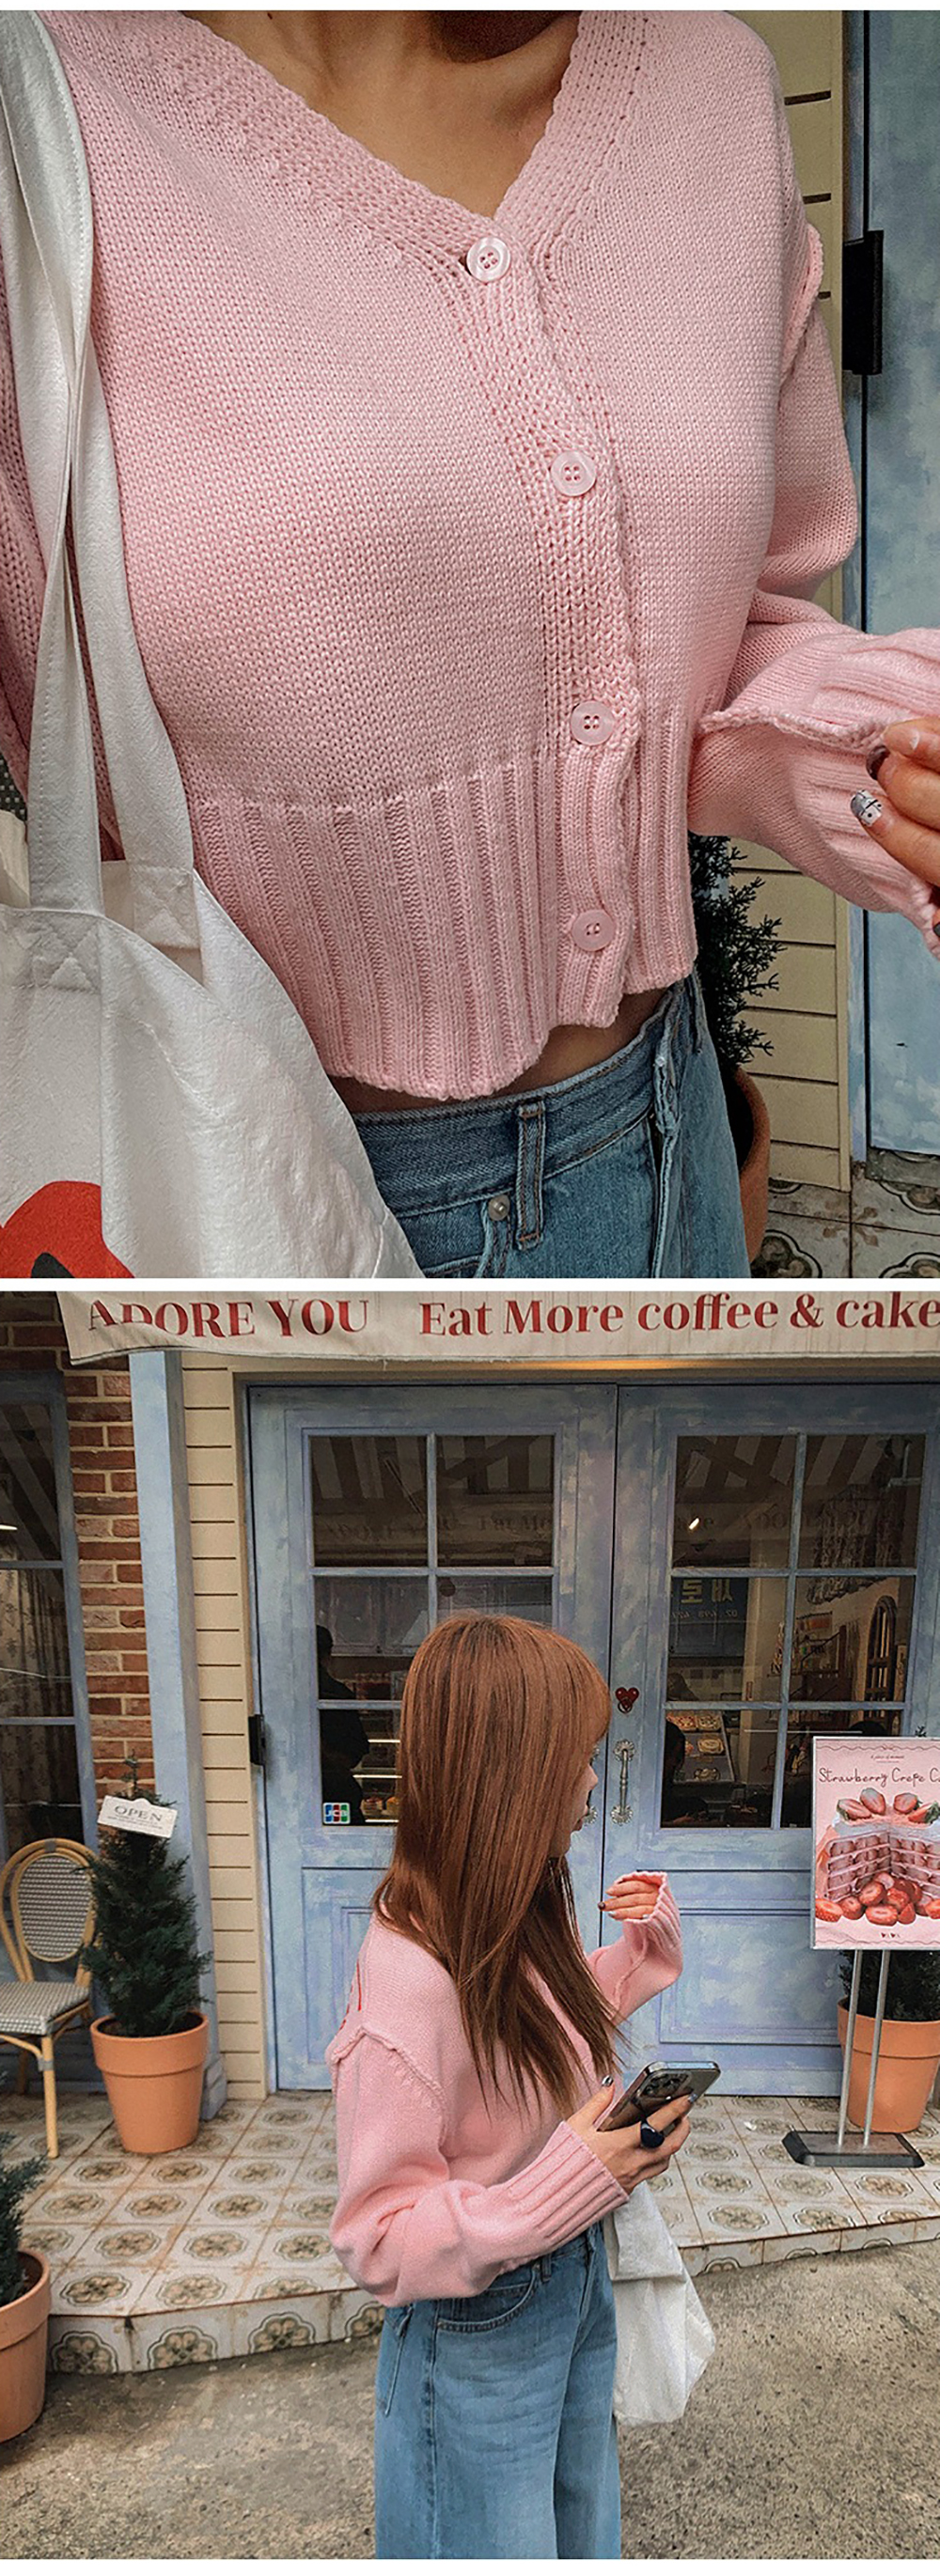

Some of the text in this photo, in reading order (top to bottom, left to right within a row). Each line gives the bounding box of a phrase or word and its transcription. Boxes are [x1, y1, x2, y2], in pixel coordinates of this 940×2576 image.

[88, 1291, 940, 1338] ADORE YOU Eat More coffee & cake
[819, 1768, 888, 1788] Strawberry
[892, 1768, 925, 1787] Crepe
[115, 1805, 163, 1821] OPEN
